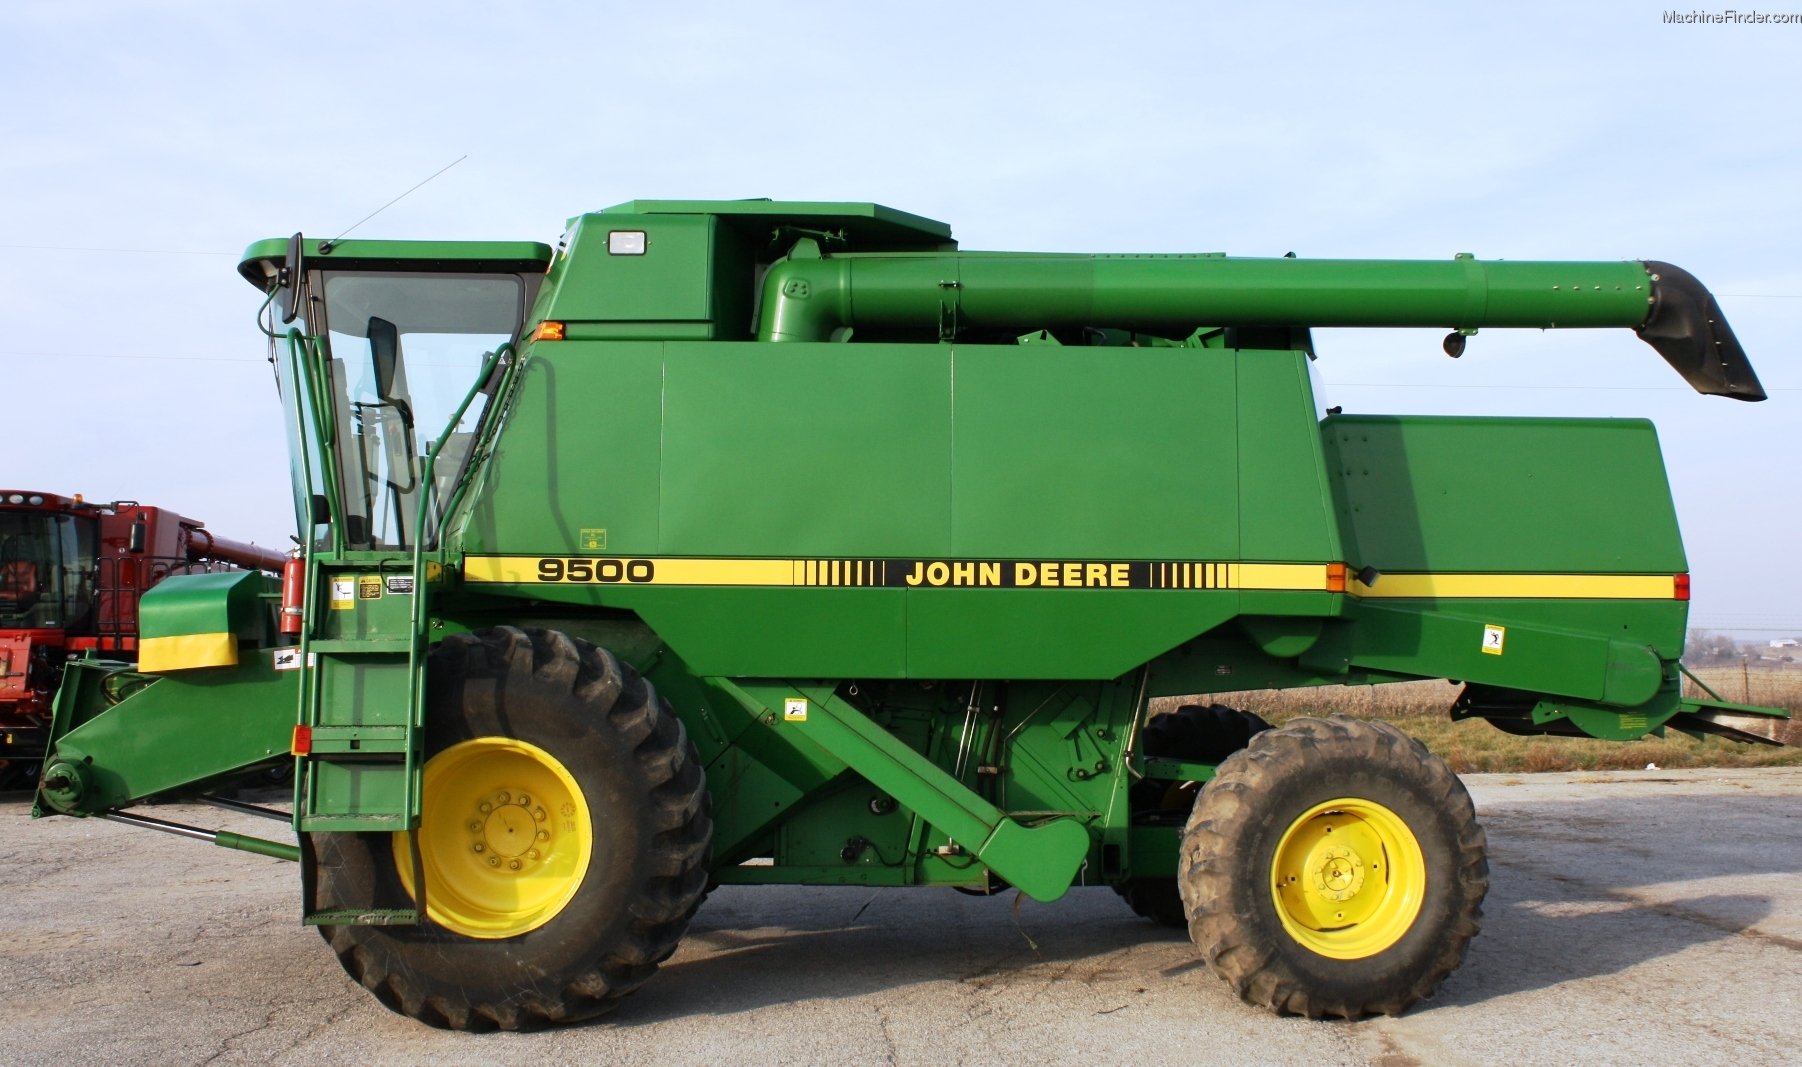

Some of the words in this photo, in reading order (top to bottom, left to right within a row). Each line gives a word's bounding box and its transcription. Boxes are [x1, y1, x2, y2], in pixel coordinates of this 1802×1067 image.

[537, 558, 655, 583] 9500
[905, 561, 1001, 586] JOHN
[1015, 562, 1130, 587] DEERE
